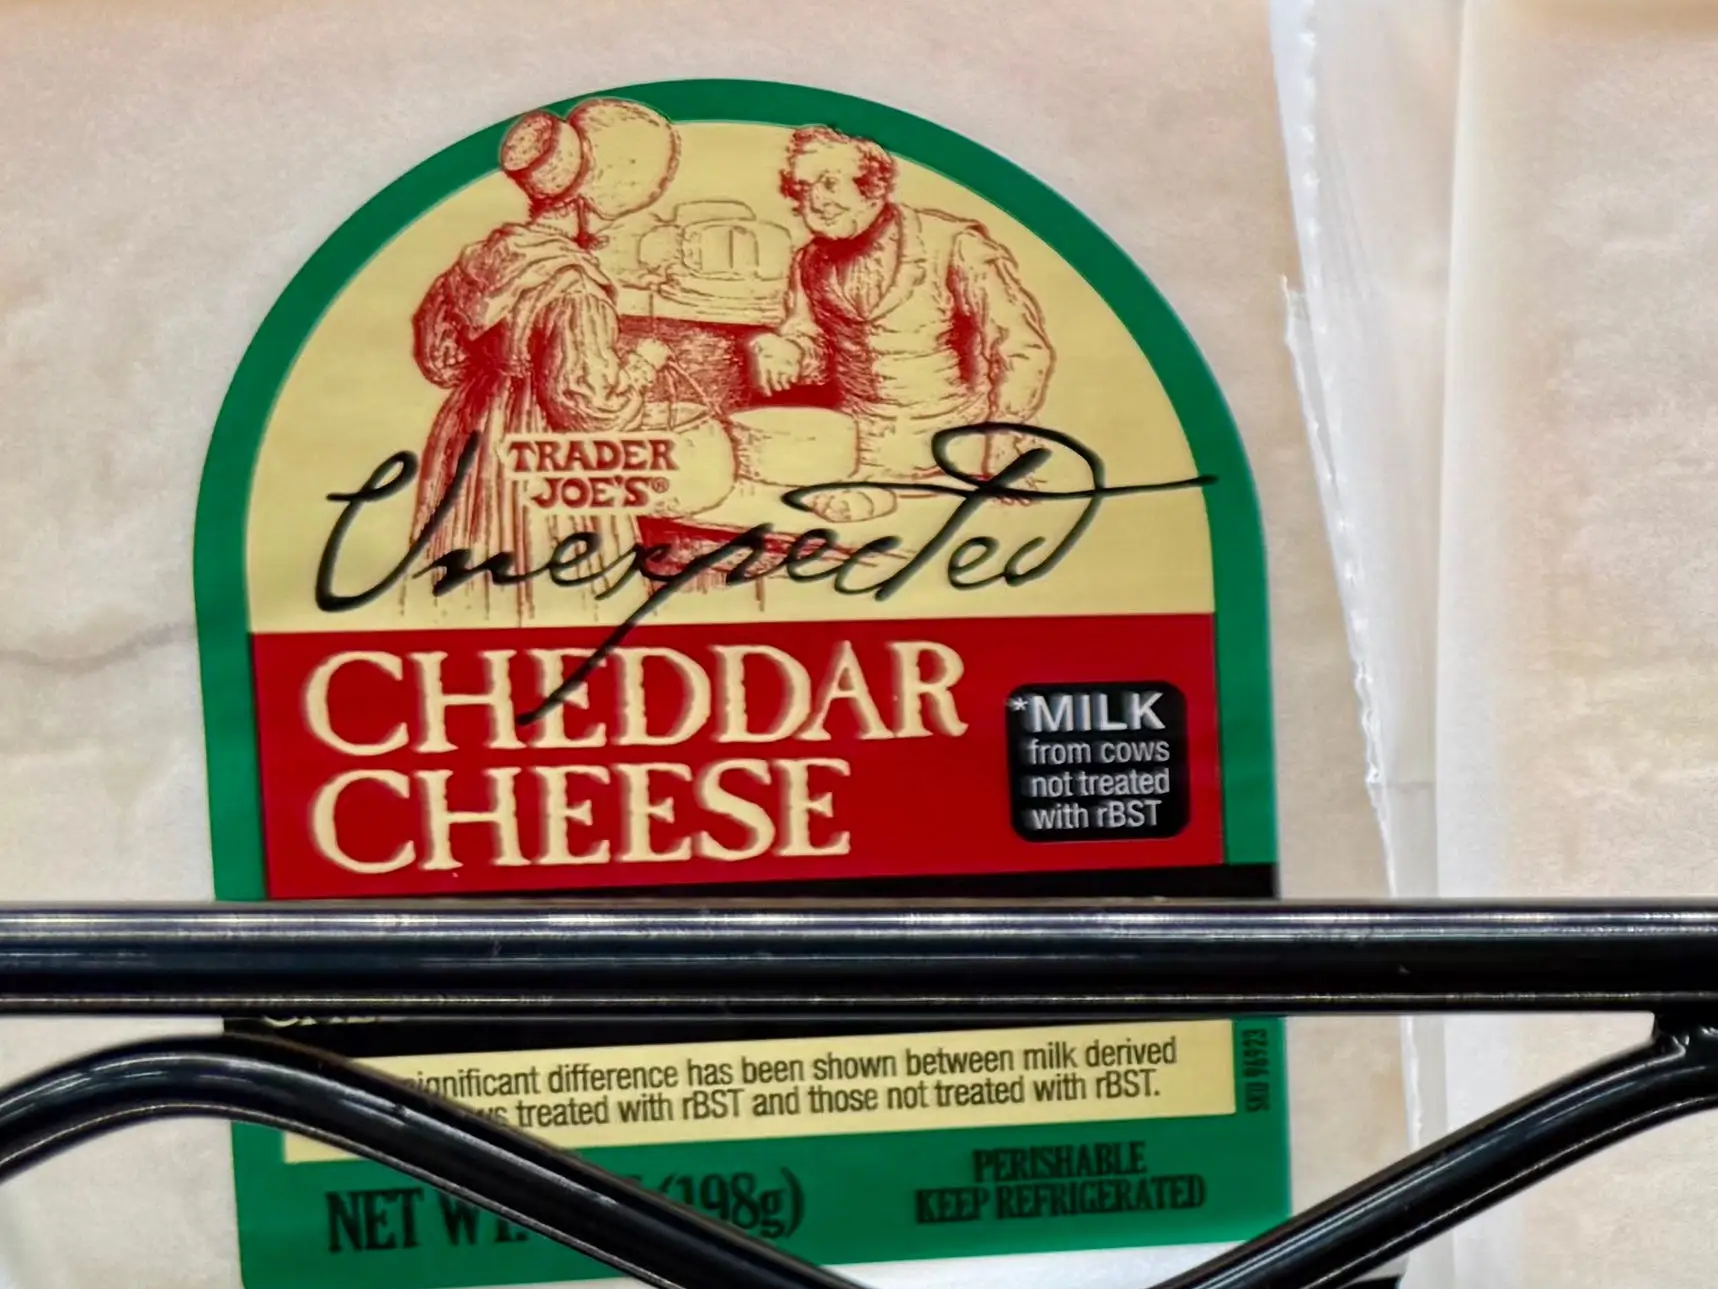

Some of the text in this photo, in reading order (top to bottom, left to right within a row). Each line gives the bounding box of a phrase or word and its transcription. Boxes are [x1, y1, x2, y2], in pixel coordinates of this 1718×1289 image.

[507, 438, 679, 474] TRADER
[313, 420, 1219, 724] Unexpected
[303, 639, 969, 756] CHEDDAR
[1027, 738, 1171, 765] from cows
[1030, 767, 1171, 798] not treated
[311, 757, 853, 874] CHEESE
[1031, 799, 1163, 830] with rBST
[402, 1035, 1179, 1098] ignificant difference has been shown between milk derived
[516, 1096, 610, 1129] treated
[618, 1091, 675, 1123] with
[682, 1089, 741, 1121] rBST
[752, 1088, 802, 1118] and
[809, 1085, 880, 1114] those
[887, 1083, 930, 1111] not
[935, 1076, 1026, 1108] treated
[1033, 1072, 1088, 1102] with
[1096, 1067, 1161, 1099] rBST.
[972, 1140, 1149, 1184] PERISHABLE
[325, 1187, 425, 1254] NET
[914, 1173, 1207, 1225] KEEP REFRIGERATED
